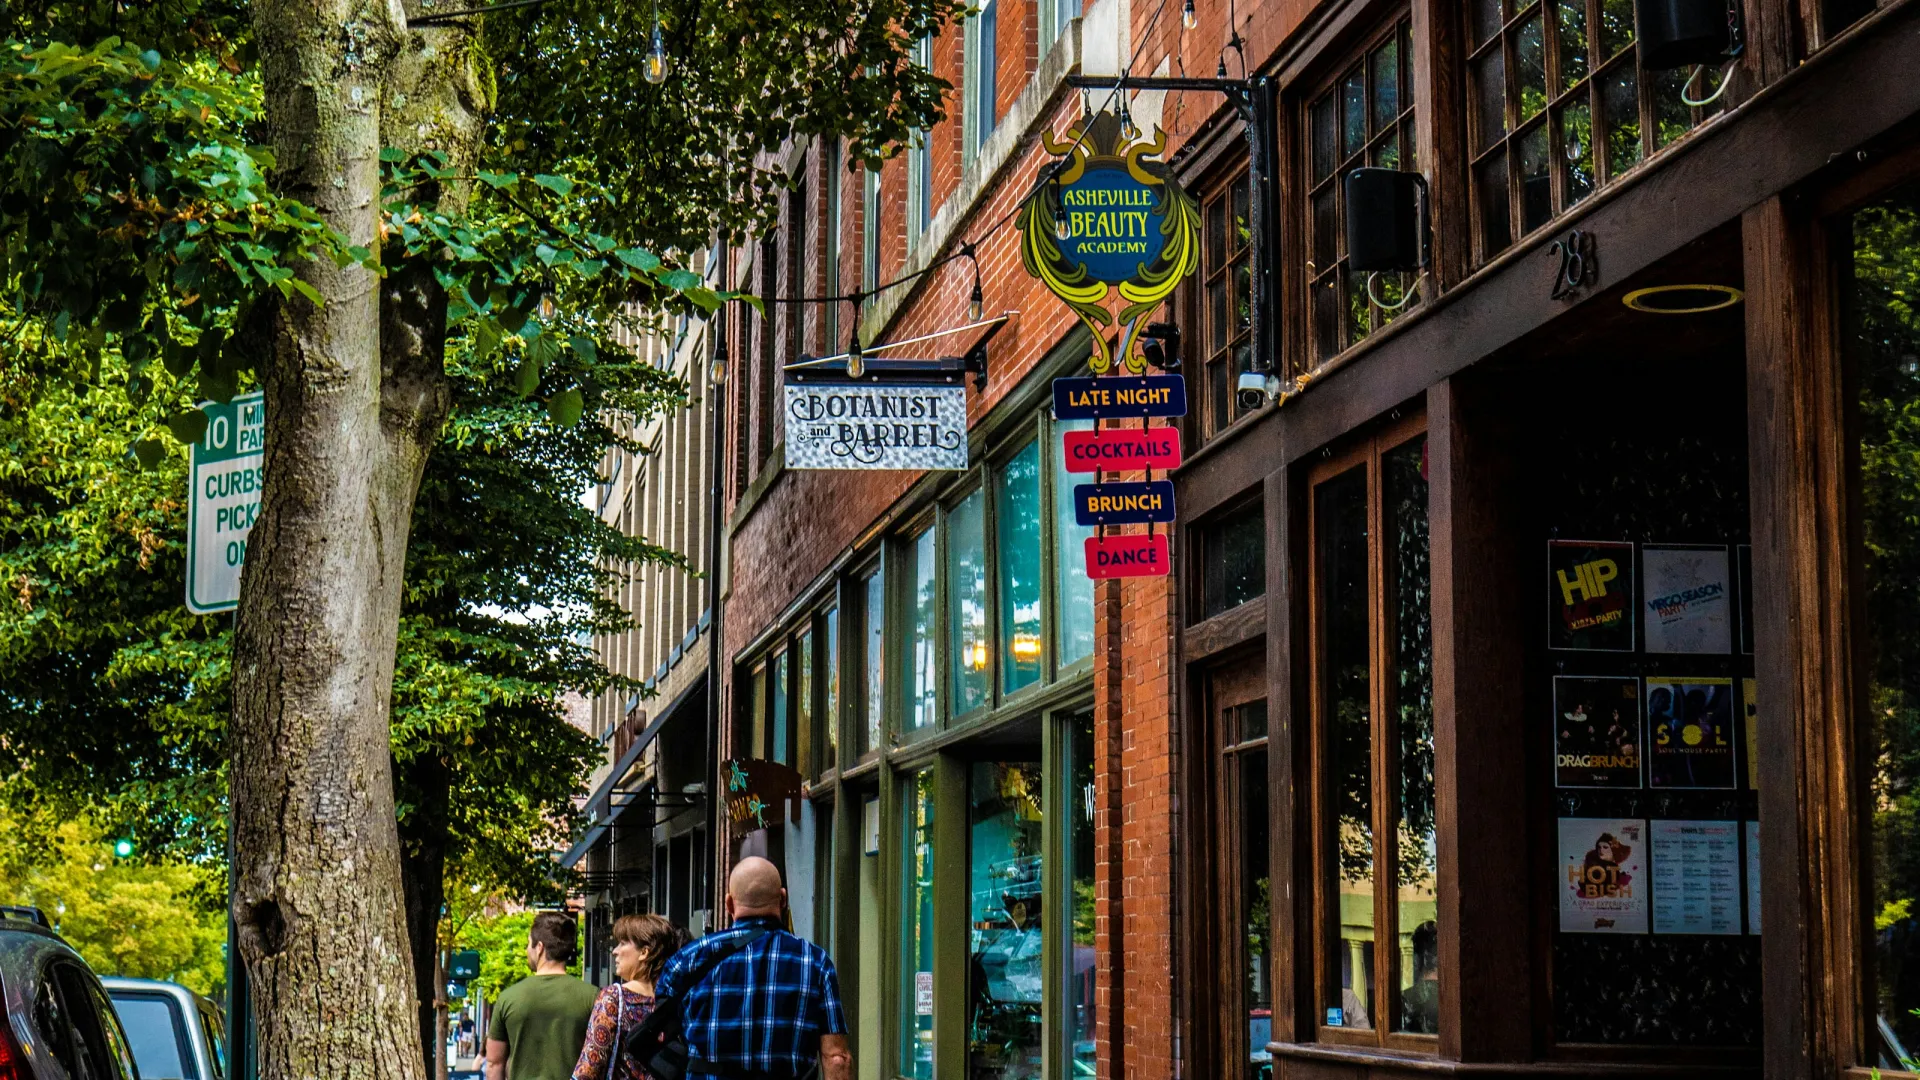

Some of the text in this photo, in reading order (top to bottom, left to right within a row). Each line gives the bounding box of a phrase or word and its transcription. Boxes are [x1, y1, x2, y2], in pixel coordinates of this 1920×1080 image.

[1064, 189, 1152, 206] ASHEVILLE
[1070, 211, 1148, 238] BEAUTY
[1077, 242, 1147, 254] ACADEMY
[1546, 229, 1584, 300] 28
[1069, 388, 1171, 407] LATE NIGHT
[791, 394, 942, 421] BOTANIST
[810, 423, 961, 464] and BARREL
[1073, 441, 1172, 460] COCKTAILS
[1087, 494, 1162, 513] BRUNCH
[216, 501, 263, 533] PICK
[1097, 548, 1158, 566] DANCE
[1556, 558, 1618, 606] HIP
[1647, 593, 1682, 612] VIRGO
[1681, 581, 1724, 602] SEASON
[1595, 609, 1622, 624] PARTY
[1657, 601, 1689, 618] PARTY
[1568, 864, 1621, 884] HOT
[1585, 883, 1633, 899] BISH
